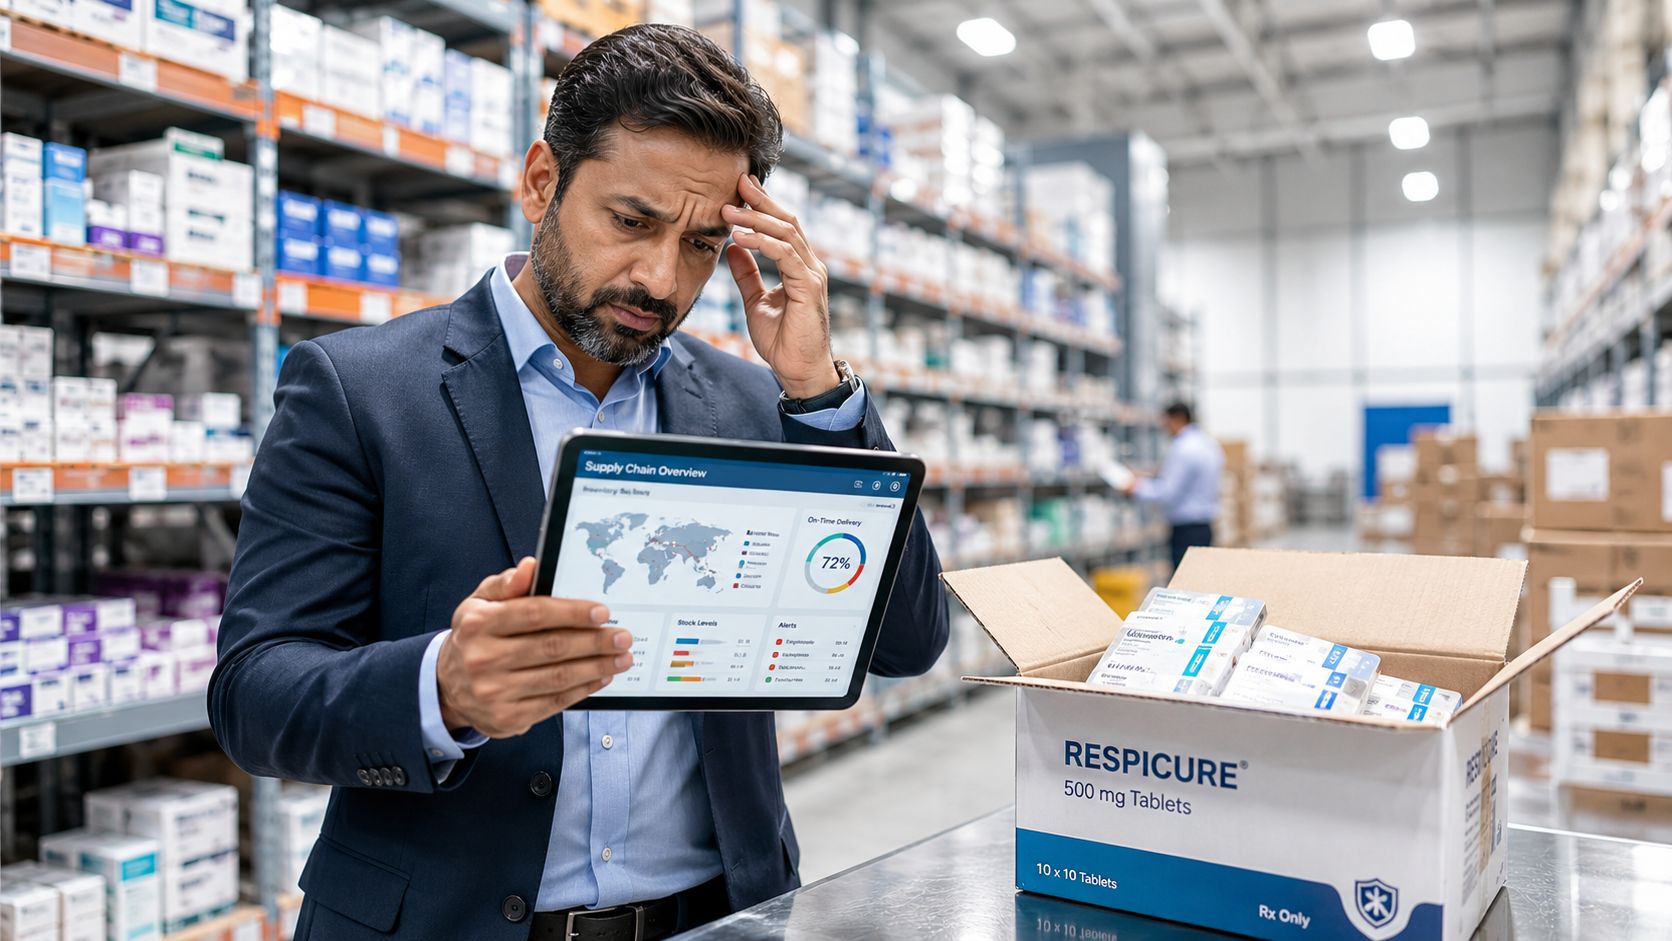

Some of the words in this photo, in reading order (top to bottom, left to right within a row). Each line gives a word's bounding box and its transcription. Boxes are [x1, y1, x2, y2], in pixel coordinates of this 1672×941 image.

[584, 460, 624, 475] Supply
[625, 463, 656, 475] Chain
[658, 465, 708, 478] Overview
[807, 516, 836, 526] On-Time
[836, 518, 862, 528] Delivery
[821, 556, 851, 570] 72%
[677, 619, 696, 627] Stock
[697, 619, 718, 627] Levels
[1064, 780, 1095, 800] 500
[1099, 789, 1126, 808] mg
[1130, 790, 1192, 815] Tablets
[1036, 863, 1051, 876] 10
[1053, 868, 1061, 878] x
[1063, 868, 1077, 881] 10
[1079, 871, 1118, 890] Tablets
[1259, 904, 1276, 920] Rx
[1279, 908, 1311, 929] Only
